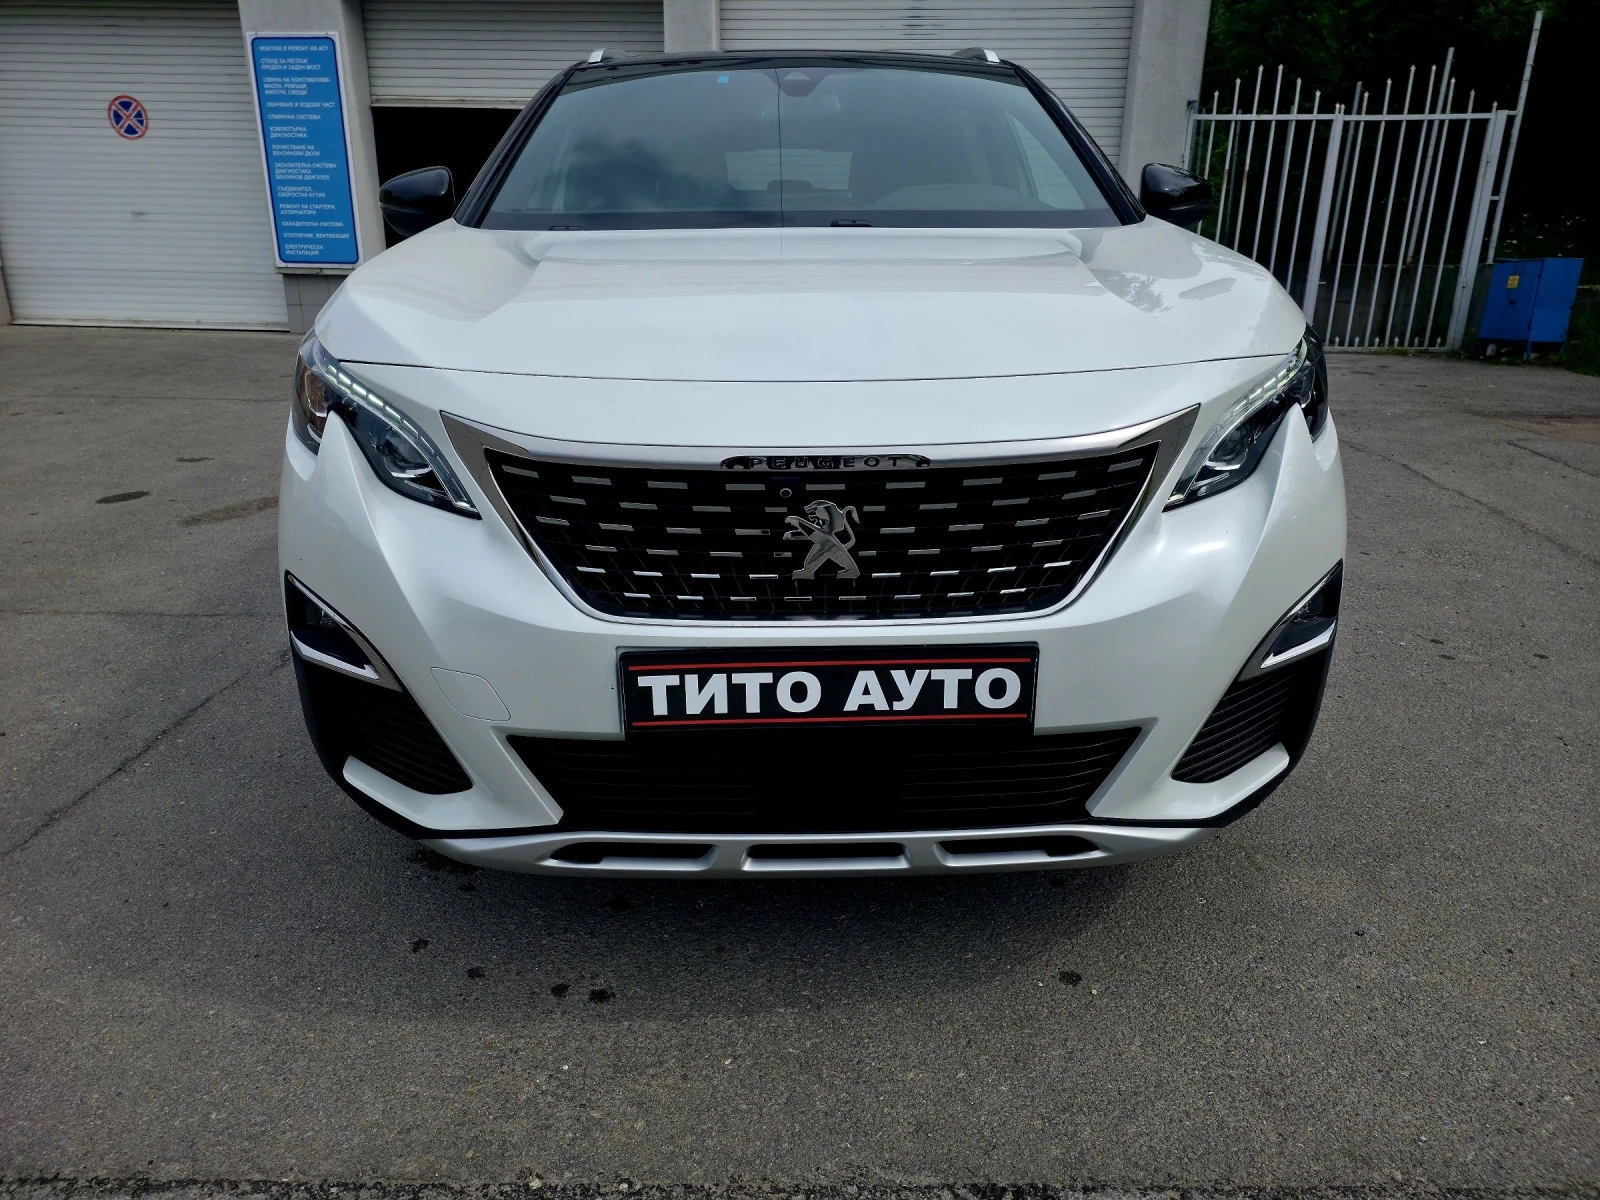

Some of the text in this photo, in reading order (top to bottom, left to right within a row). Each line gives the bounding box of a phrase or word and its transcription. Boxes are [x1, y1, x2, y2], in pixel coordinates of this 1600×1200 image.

[750, 456, 902, 469] PEUGEOT
[637, 667, 1021, 716] ТИТО АУТО
